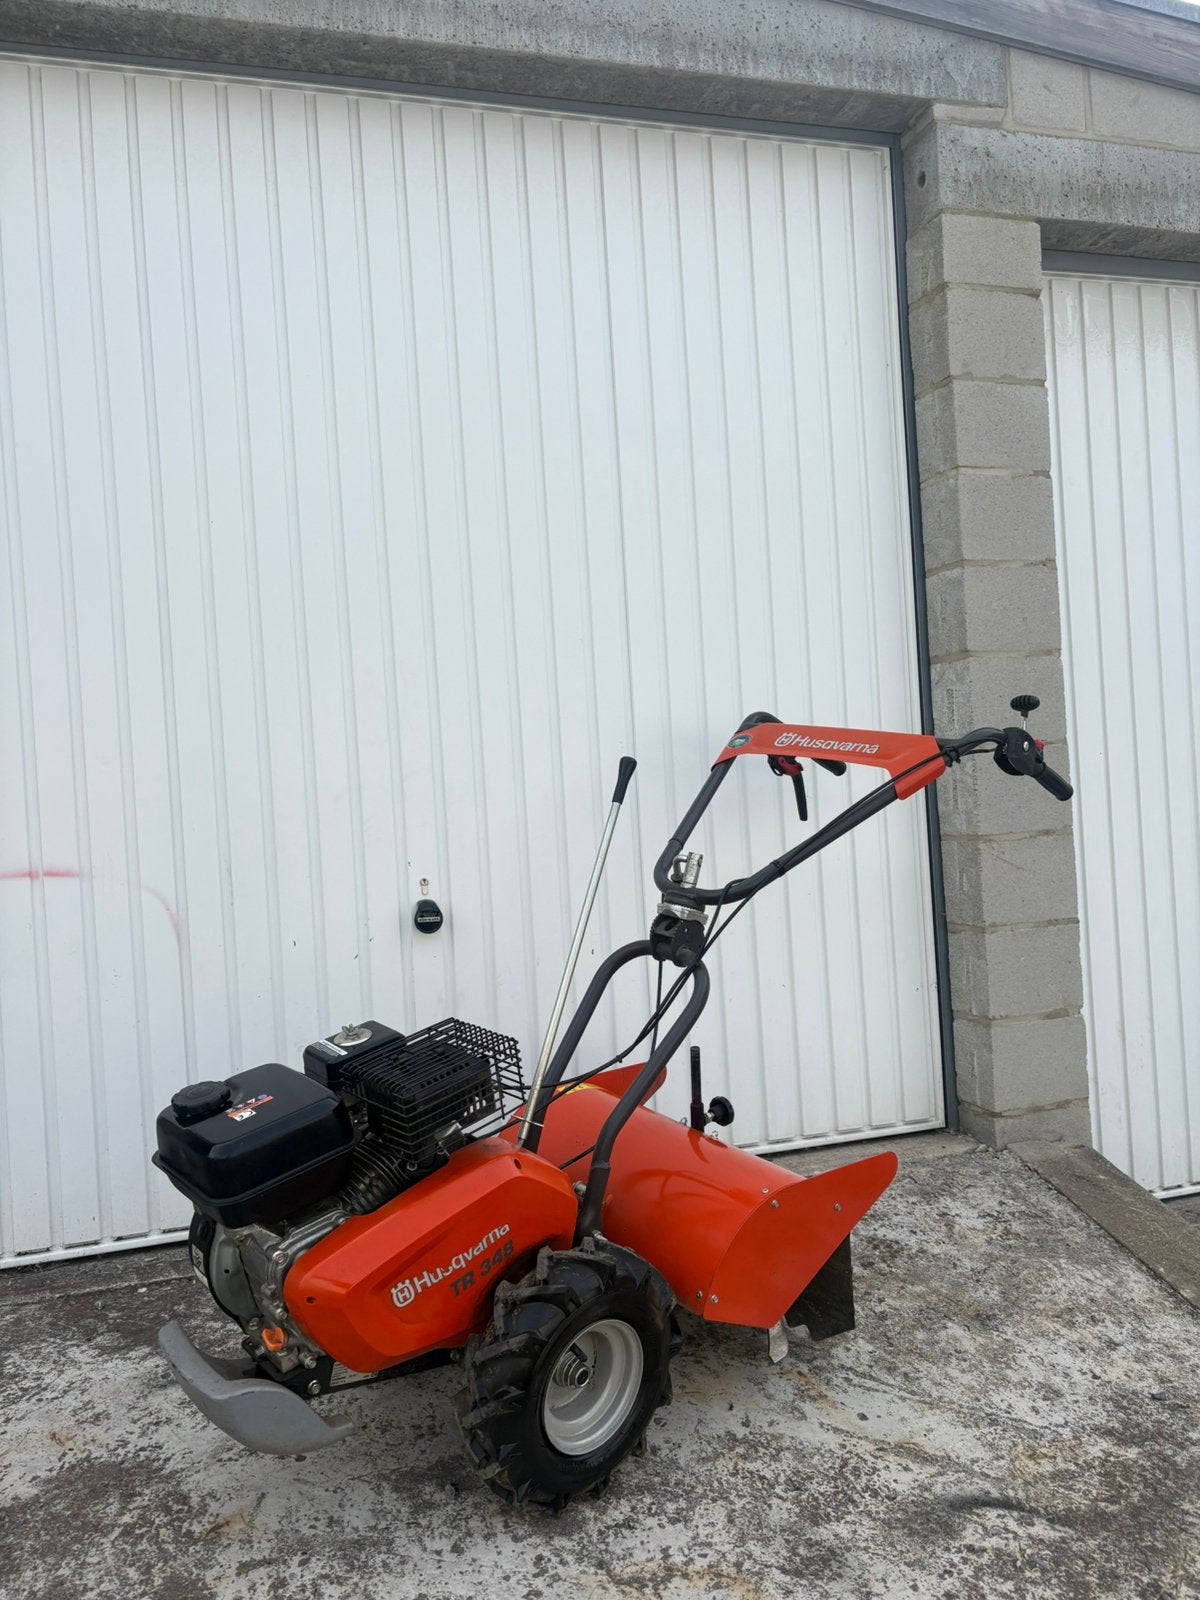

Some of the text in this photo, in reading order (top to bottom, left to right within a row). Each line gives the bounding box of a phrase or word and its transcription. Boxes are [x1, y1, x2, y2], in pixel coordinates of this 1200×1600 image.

[792, 735, 879, 754] Husqvarna
[413, 1224, 510, 1293] Husqvarna
[450, 1240, 513, 1296] TR 348
